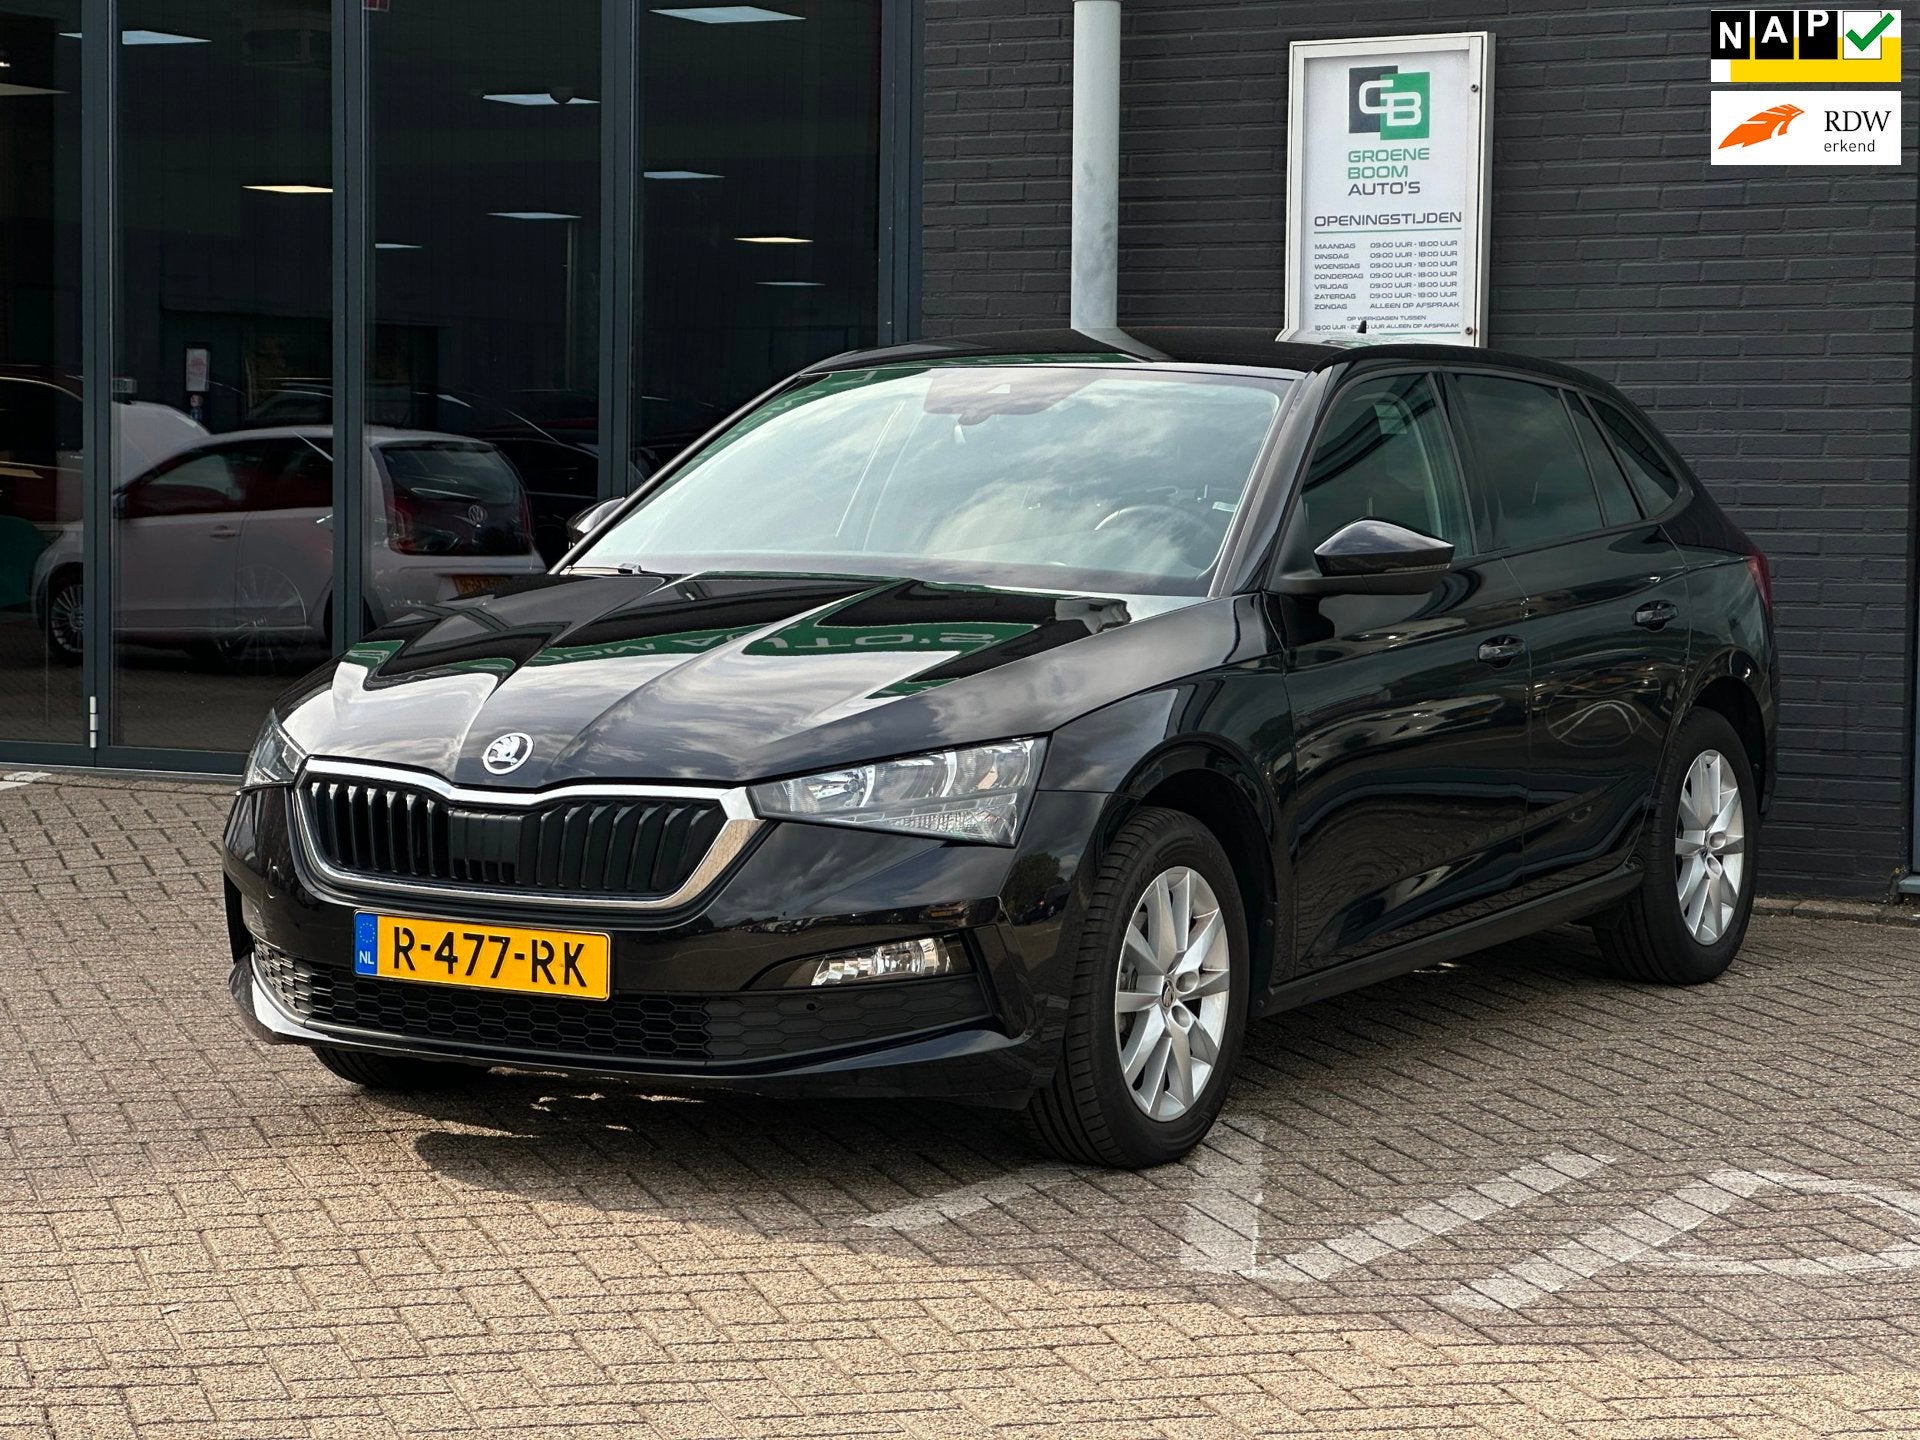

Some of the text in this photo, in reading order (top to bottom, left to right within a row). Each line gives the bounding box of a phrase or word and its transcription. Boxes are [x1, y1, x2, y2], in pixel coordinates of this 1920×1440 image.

[1347, 147, 1430, 163] GROENE
[1347, 165, 1409, 180] BOOM
[1348, 181, 1421, 196] AUTO'S
[1314, 211, 1462, 227] OPENINGSTIJDEN
[358, 950, 375, 966] NL
[393, 926, 588, 988] R-477-RK
